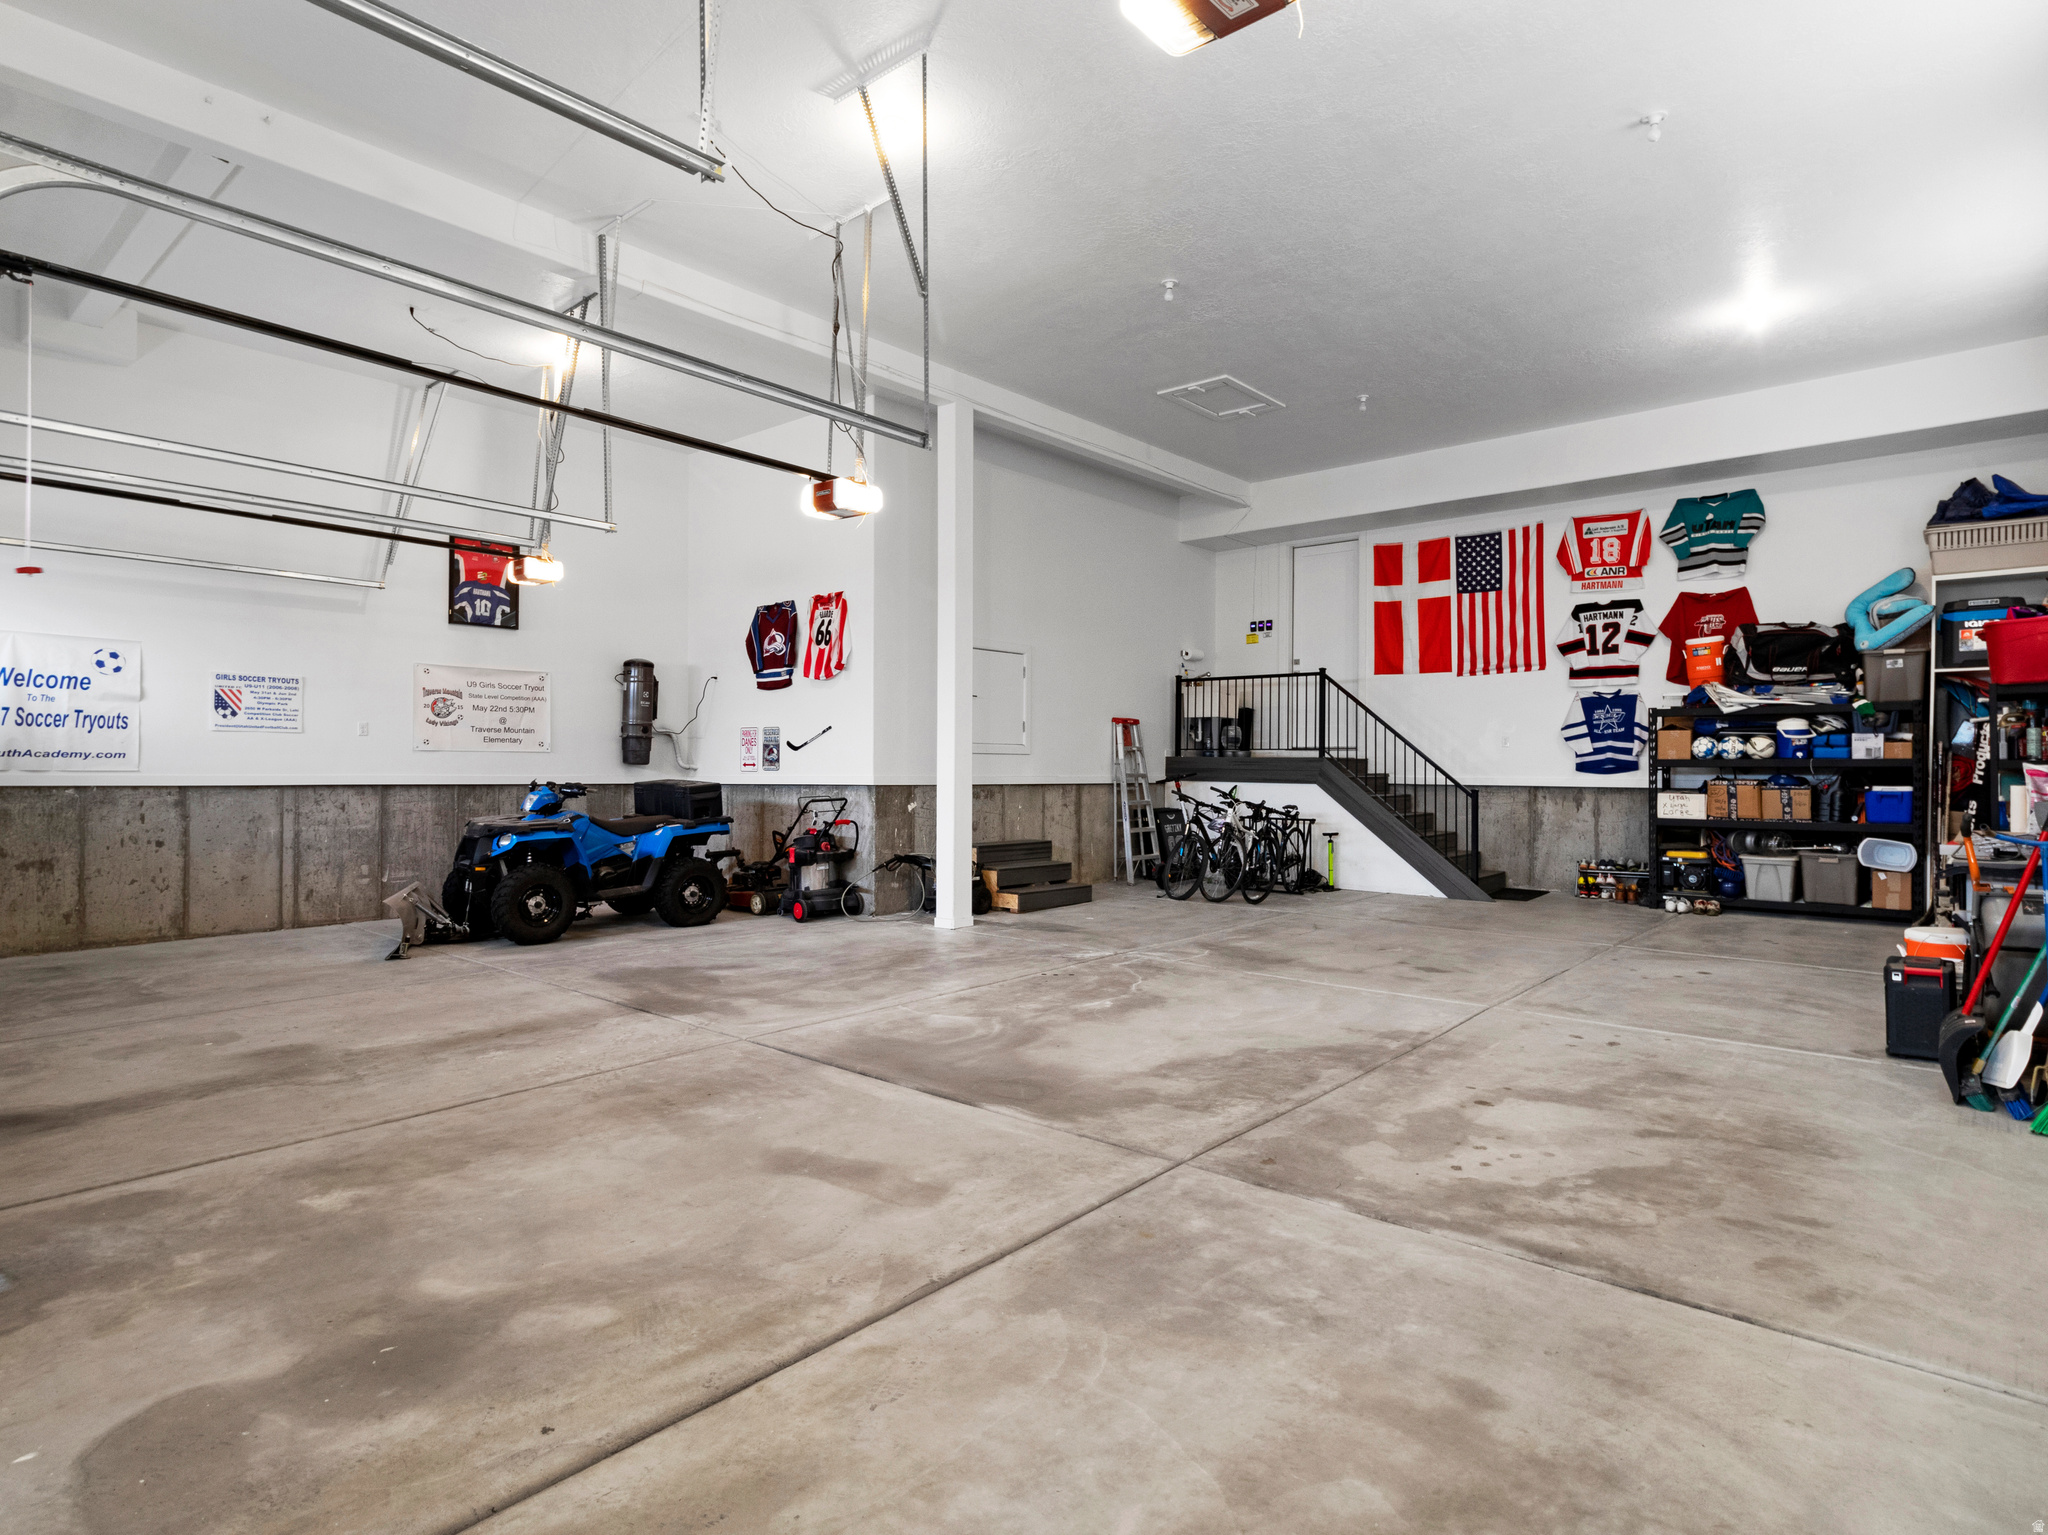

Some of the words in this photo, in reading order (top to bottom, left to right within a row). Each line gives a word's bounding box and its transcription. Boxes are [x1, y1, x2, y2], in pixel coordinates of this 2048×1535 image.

[1691, 519, 1736, 533] UTAH
[1590, 537, 1621, 564] 18
[1600, 566, 1626, 576] ANR
[1581, 580, 1624, 590] HARTMANN
[474, 598, 492, 617] 10
[1583, 610, 1624, 622] HARTMANN
[815, 618, 832, 646] 66
[1585, 621, 1621, 656] 12
[215, 673, 237, 681] GIRLS
[238, 675, 266, 683] SOCCER
[268, 676, 299, 685] TRYOUTS
[466, 680, 478, 688] U9
[478, 681, 496, 689] Girls
[497, 682, 522, 691] Soccer
[523, 683, 545, 693] Tryout
[27, 693, 38, 702] To
[40, 693, 56, 703] The
[499, 694, 531, 702] Competition
[472, 704, 488, 713] May
[489, 705, 508, 713] 22nd
[509, 706, 536, 714] 5:30PM
[14, 706, 70, 728] Soccer
[74, 709, 129, 734] Tryouts
[498, 716, 508, 725] @
[470, 725, 502, 734] Traverse
[503, 726, 536, 734] Mountain
[483, 736, 523, 745] Elementary
[741, 737, 757, 747] DANES
